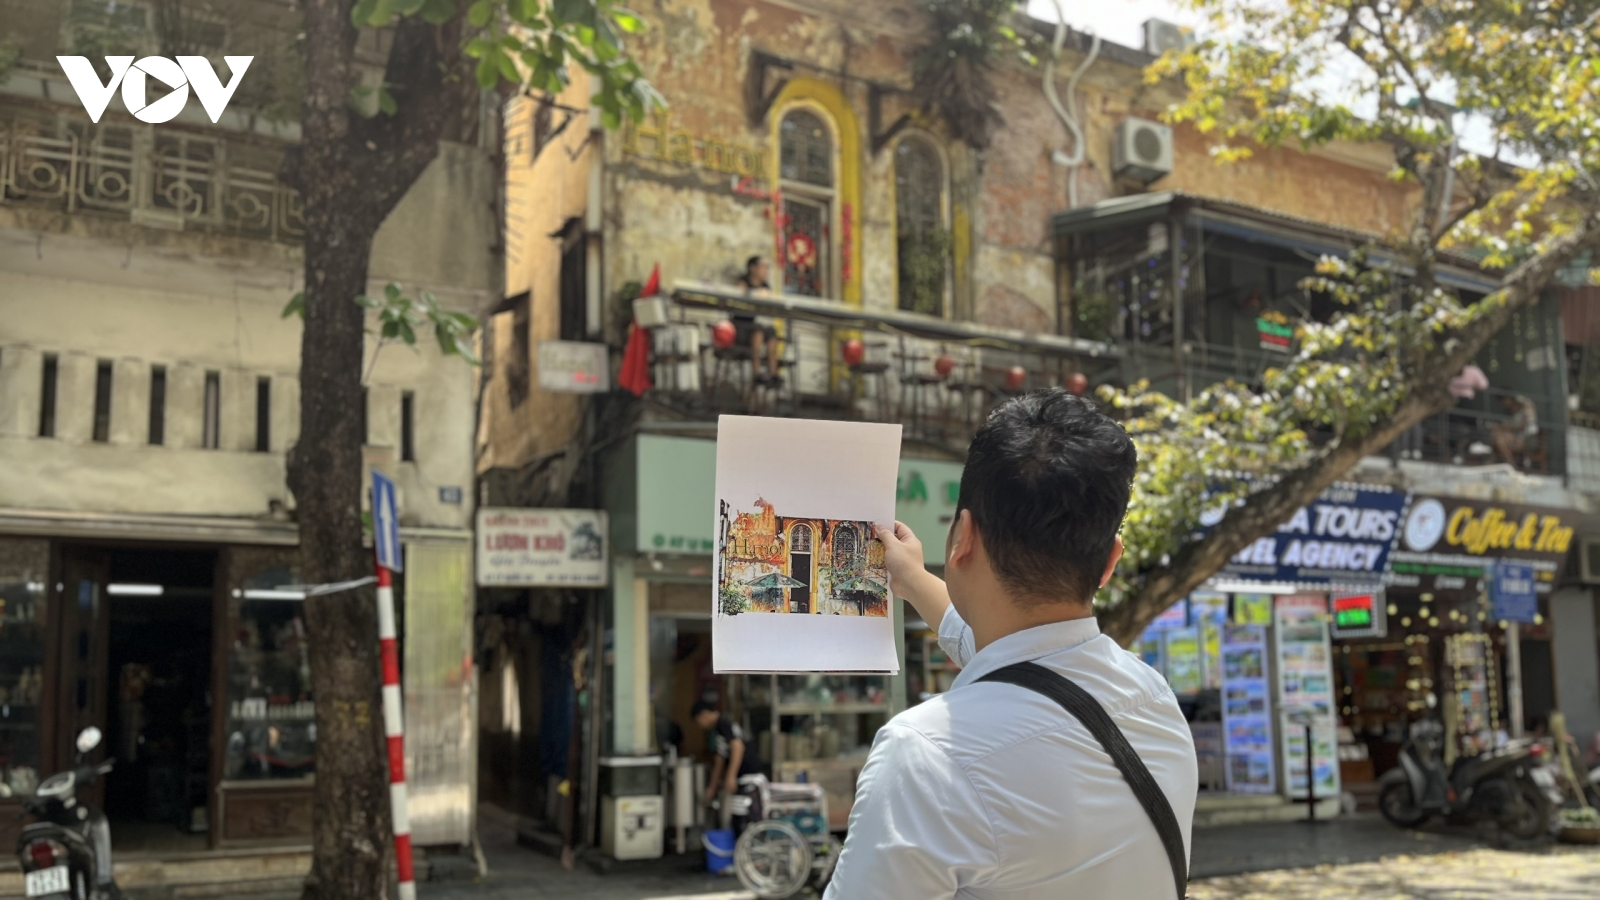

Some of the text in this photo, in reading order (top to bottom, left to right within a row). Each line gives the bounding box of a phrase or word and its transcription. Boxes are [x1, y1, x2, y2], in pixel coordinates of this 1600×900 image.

[1315, 505, 1397, 541] TOURS
[1446, 506, 1573, 554] Coffee & Tea
[1282, 540, 1382, 570] AGENCY
